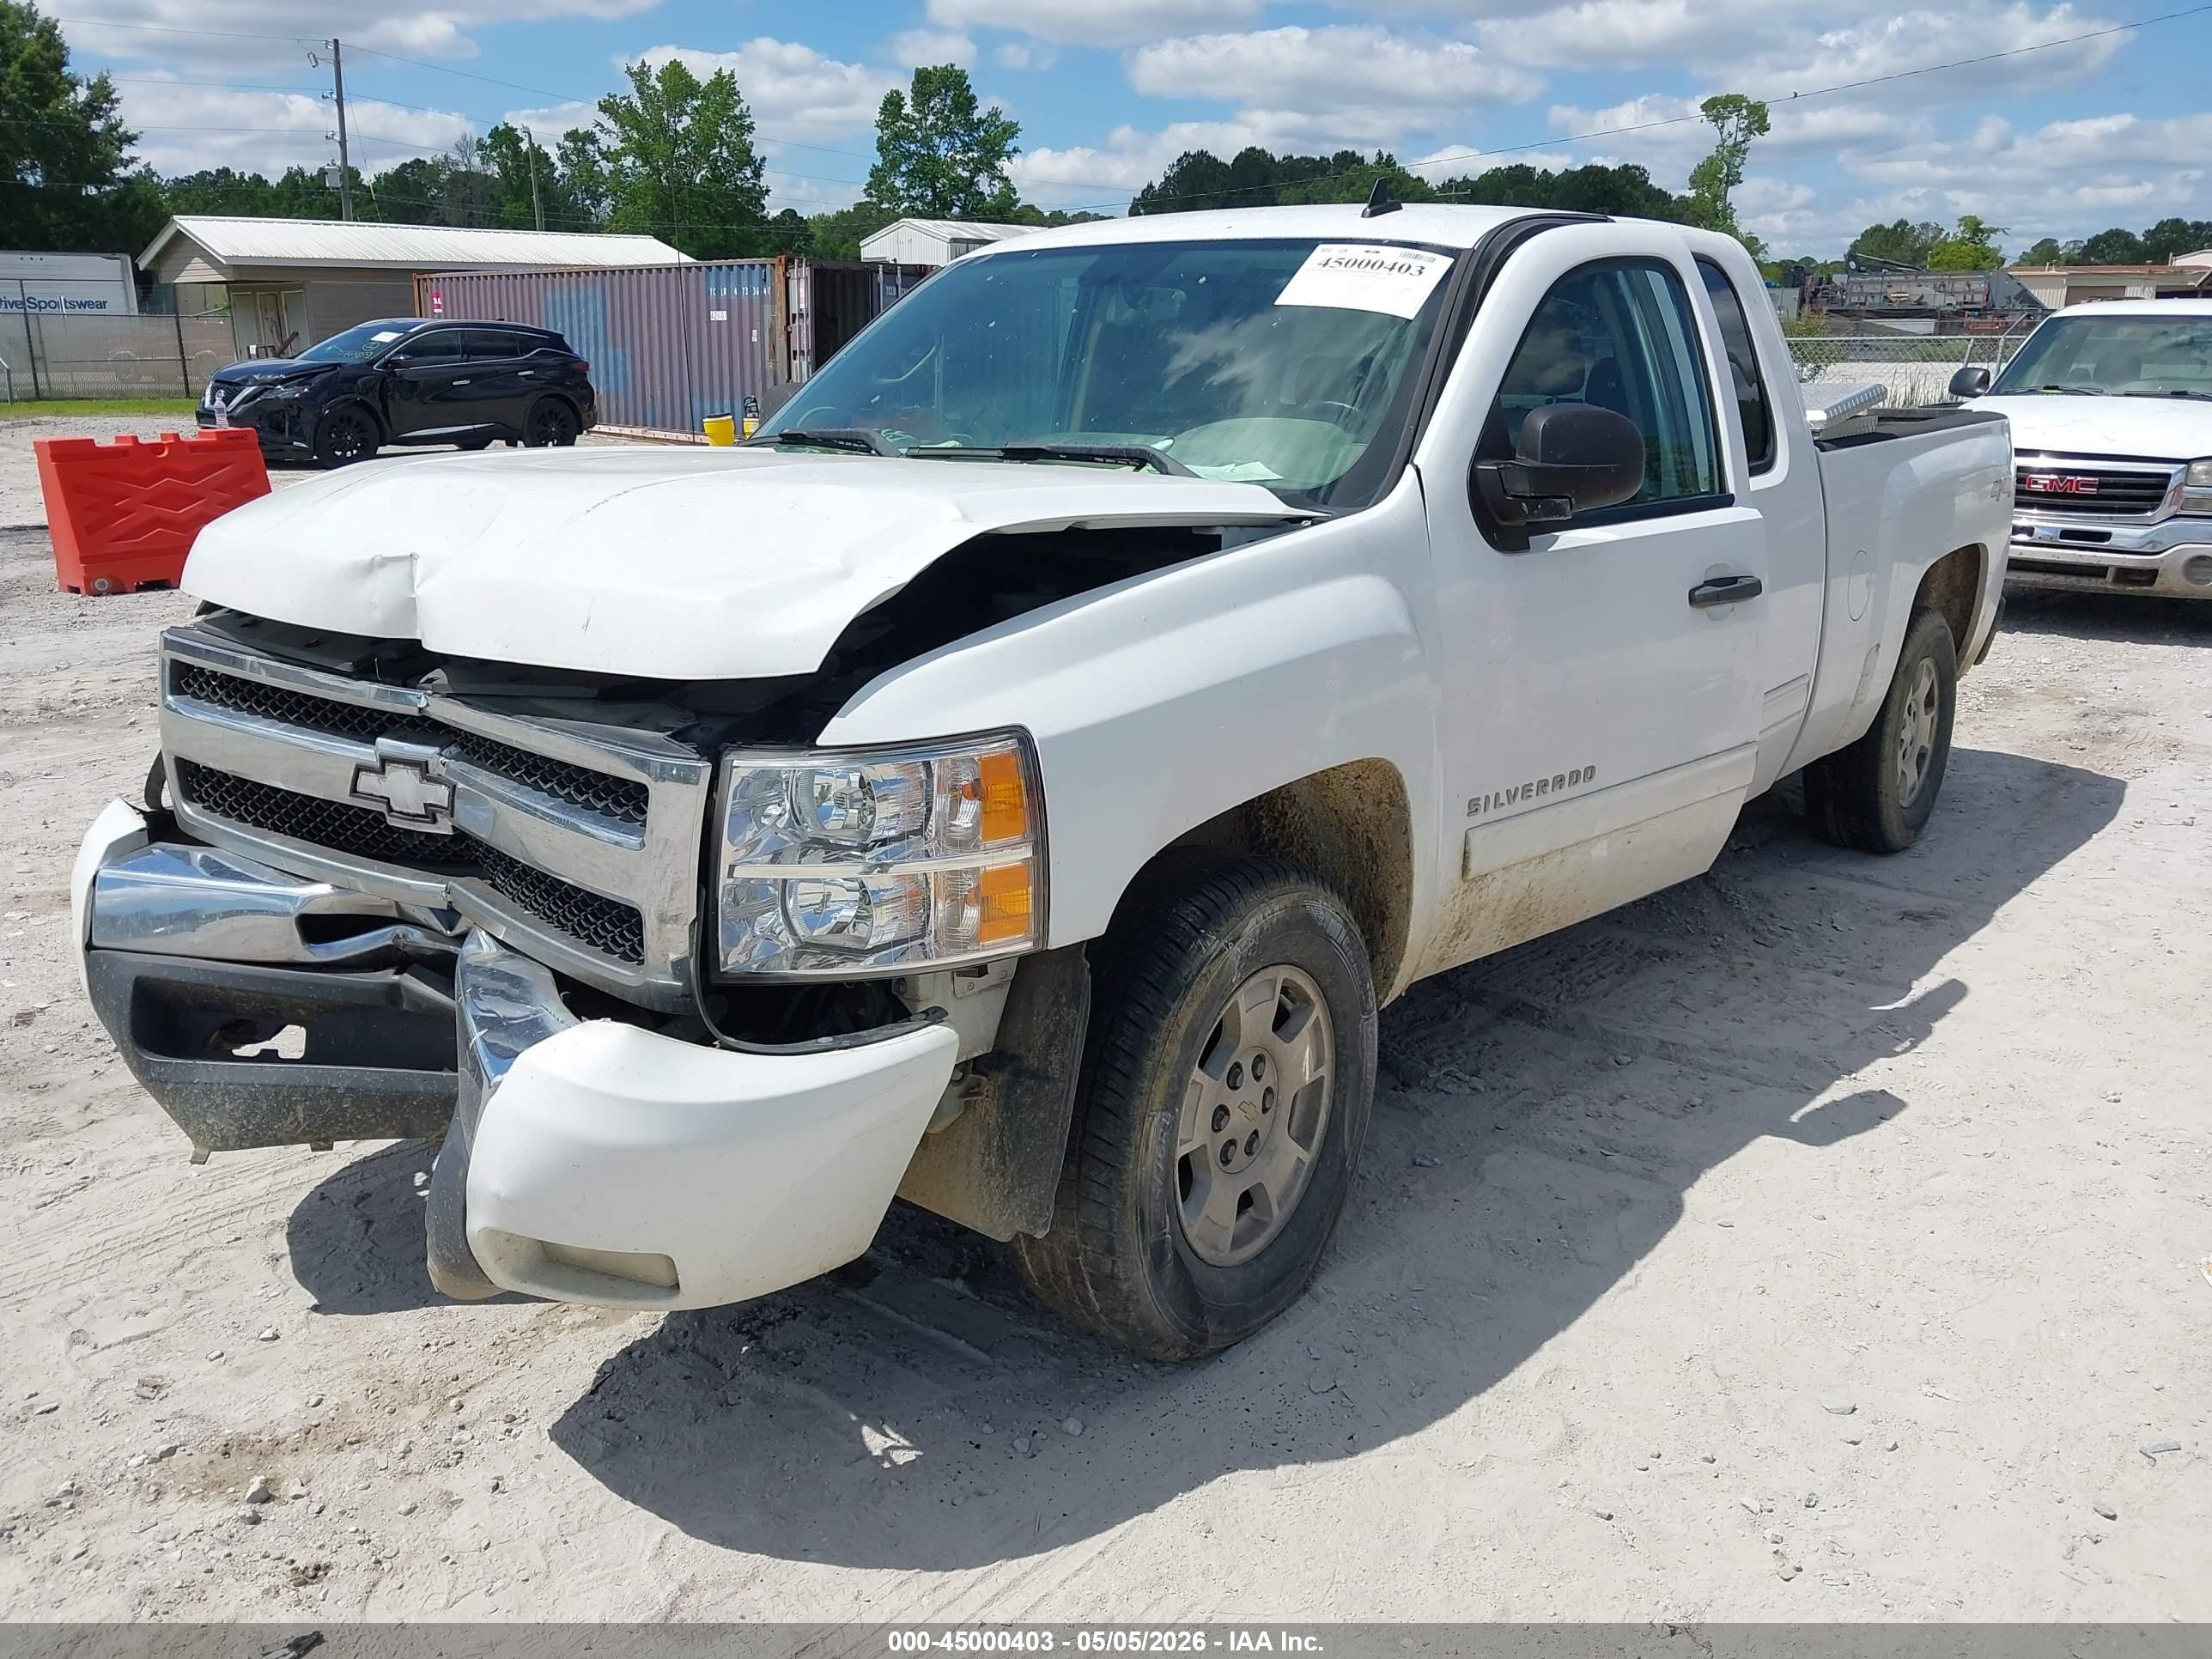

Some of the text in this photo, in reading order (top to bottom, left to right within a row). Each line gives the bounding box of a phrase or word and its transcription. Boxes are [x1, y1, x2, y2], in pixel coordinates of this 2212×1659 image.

[1317, 257, 1425, 276] 45000403
[2026, 474, 2099, 495] GMC
[1467, 764, 1596, 817] SILVERADO
